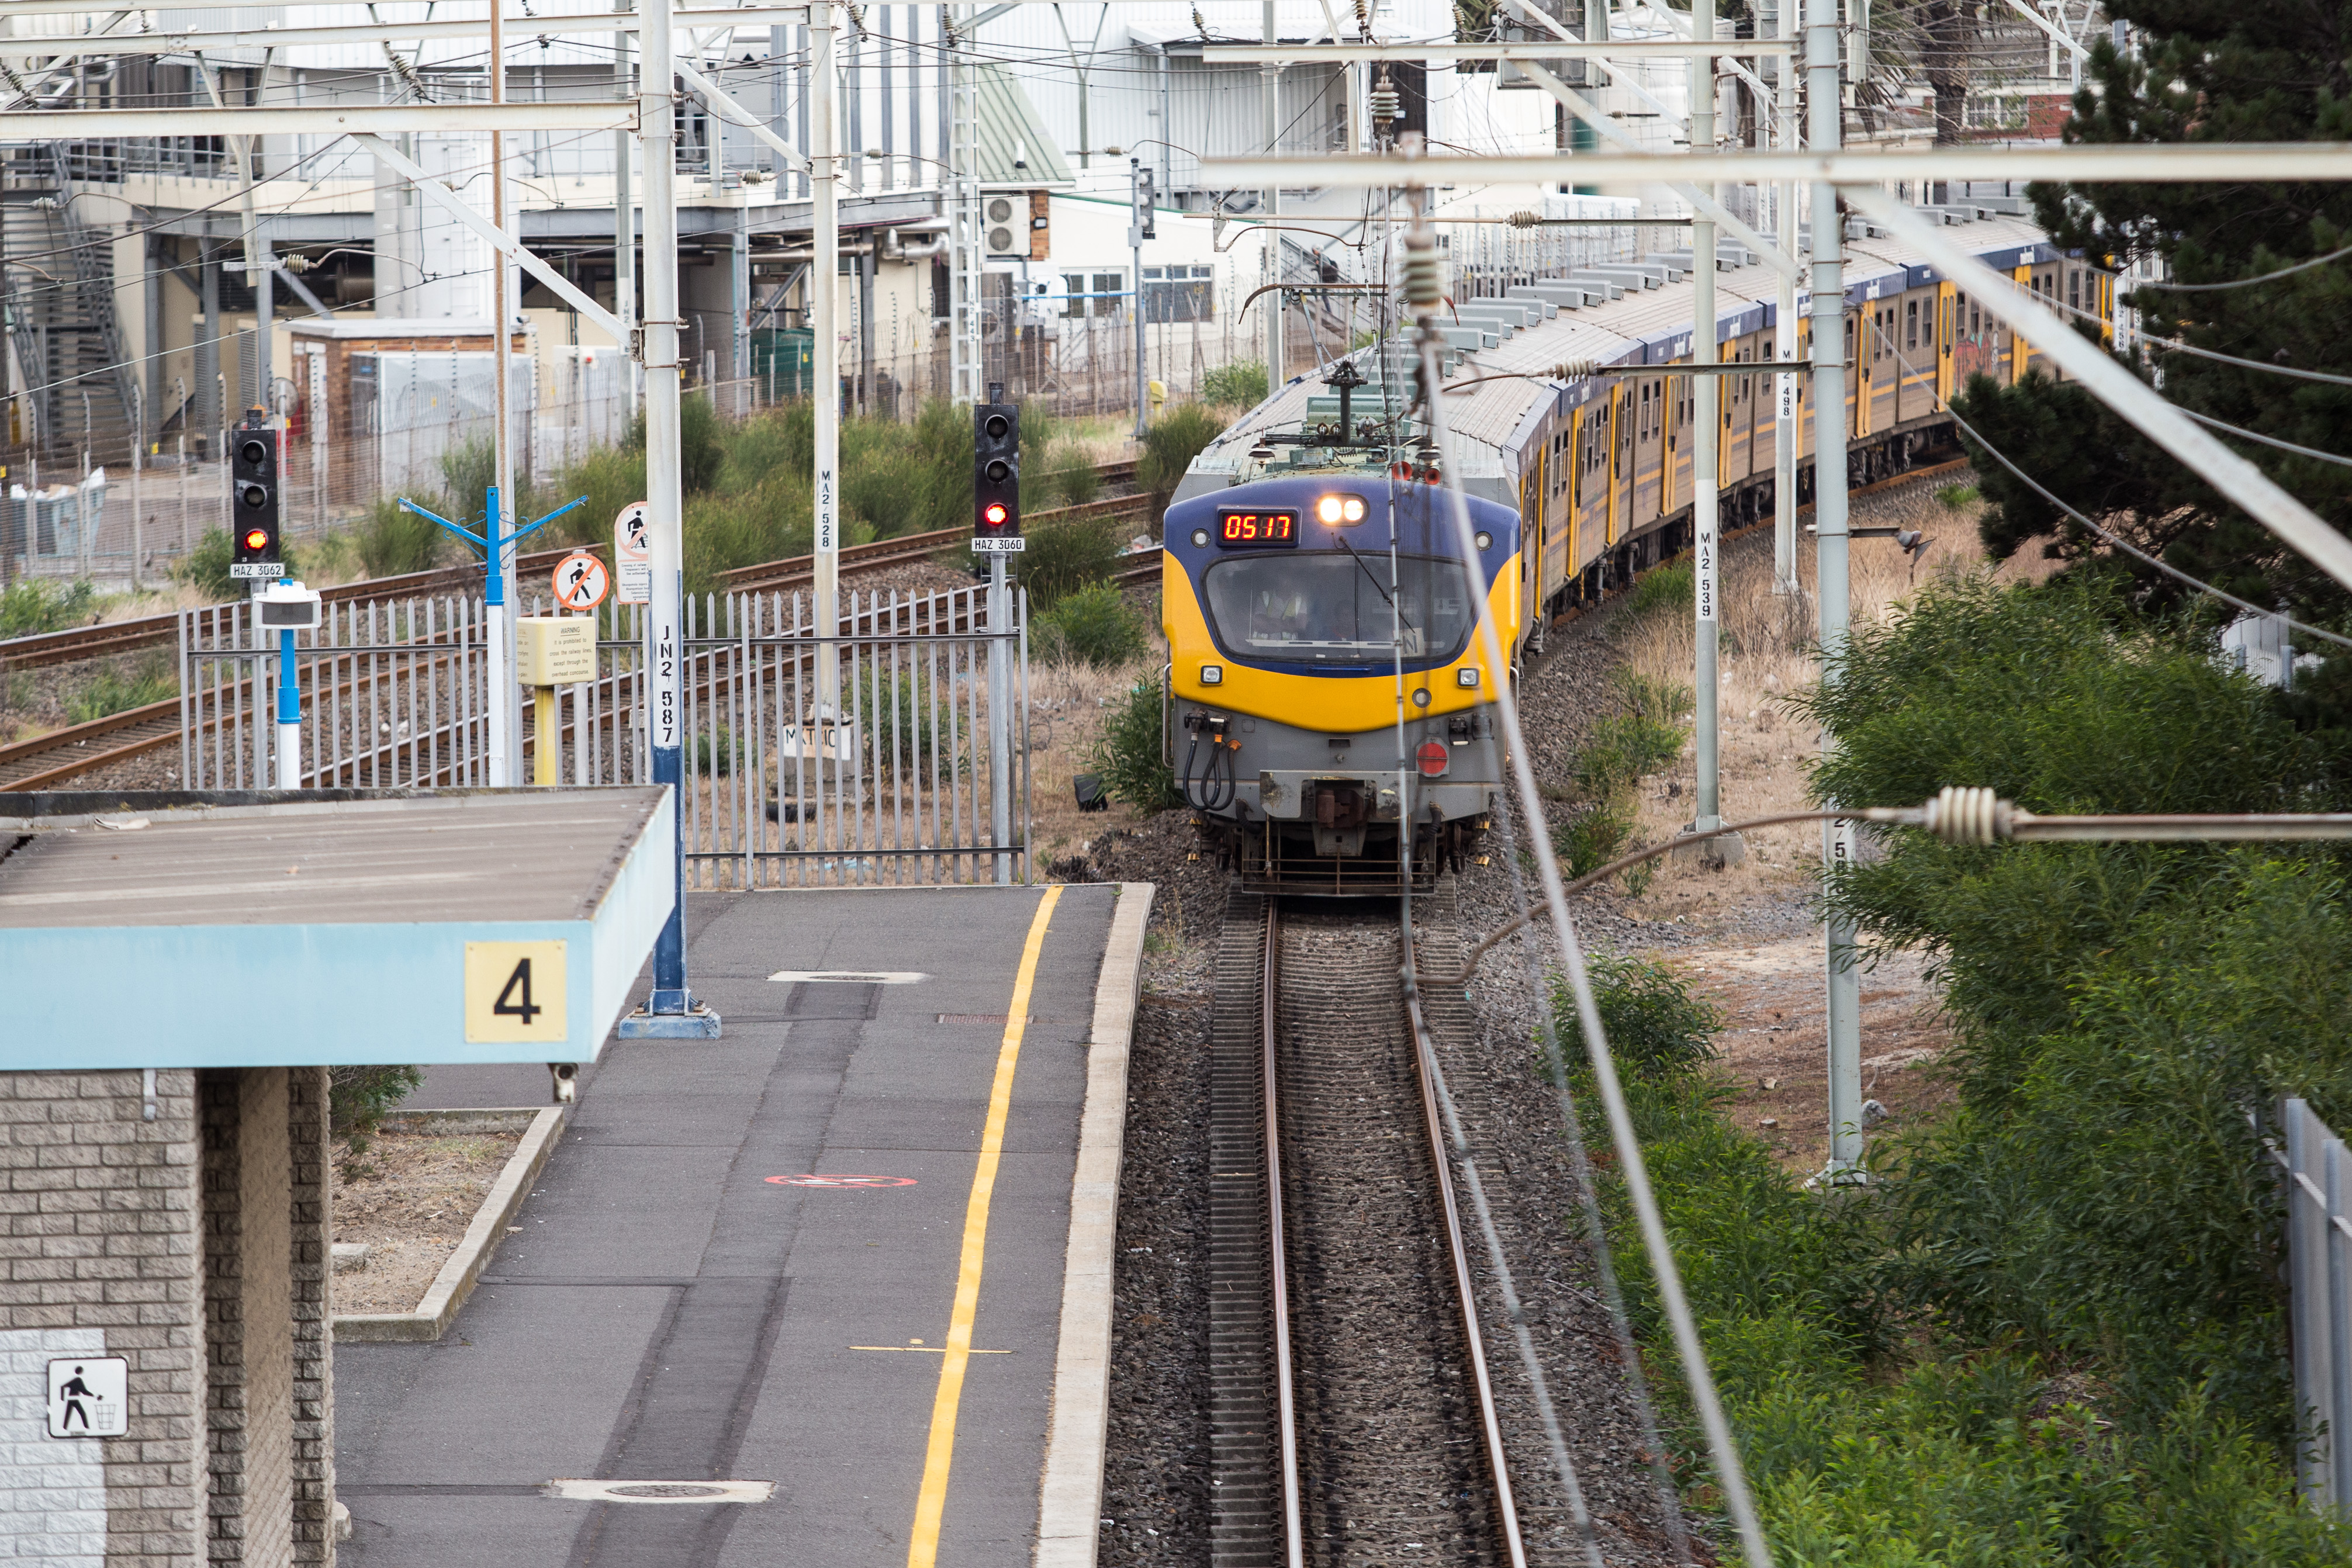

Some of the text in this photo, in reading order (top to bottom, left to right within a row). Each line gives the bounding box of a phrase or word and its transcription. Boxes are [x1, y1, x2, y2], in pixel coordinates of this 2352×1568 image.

[1225, 515, 1290, 538] 0517
[975, 539, 1022, 549] HAZ 3060
[234, 565, 281, 576] HAZ 3062
[493, 958, 541, 1025] 4
